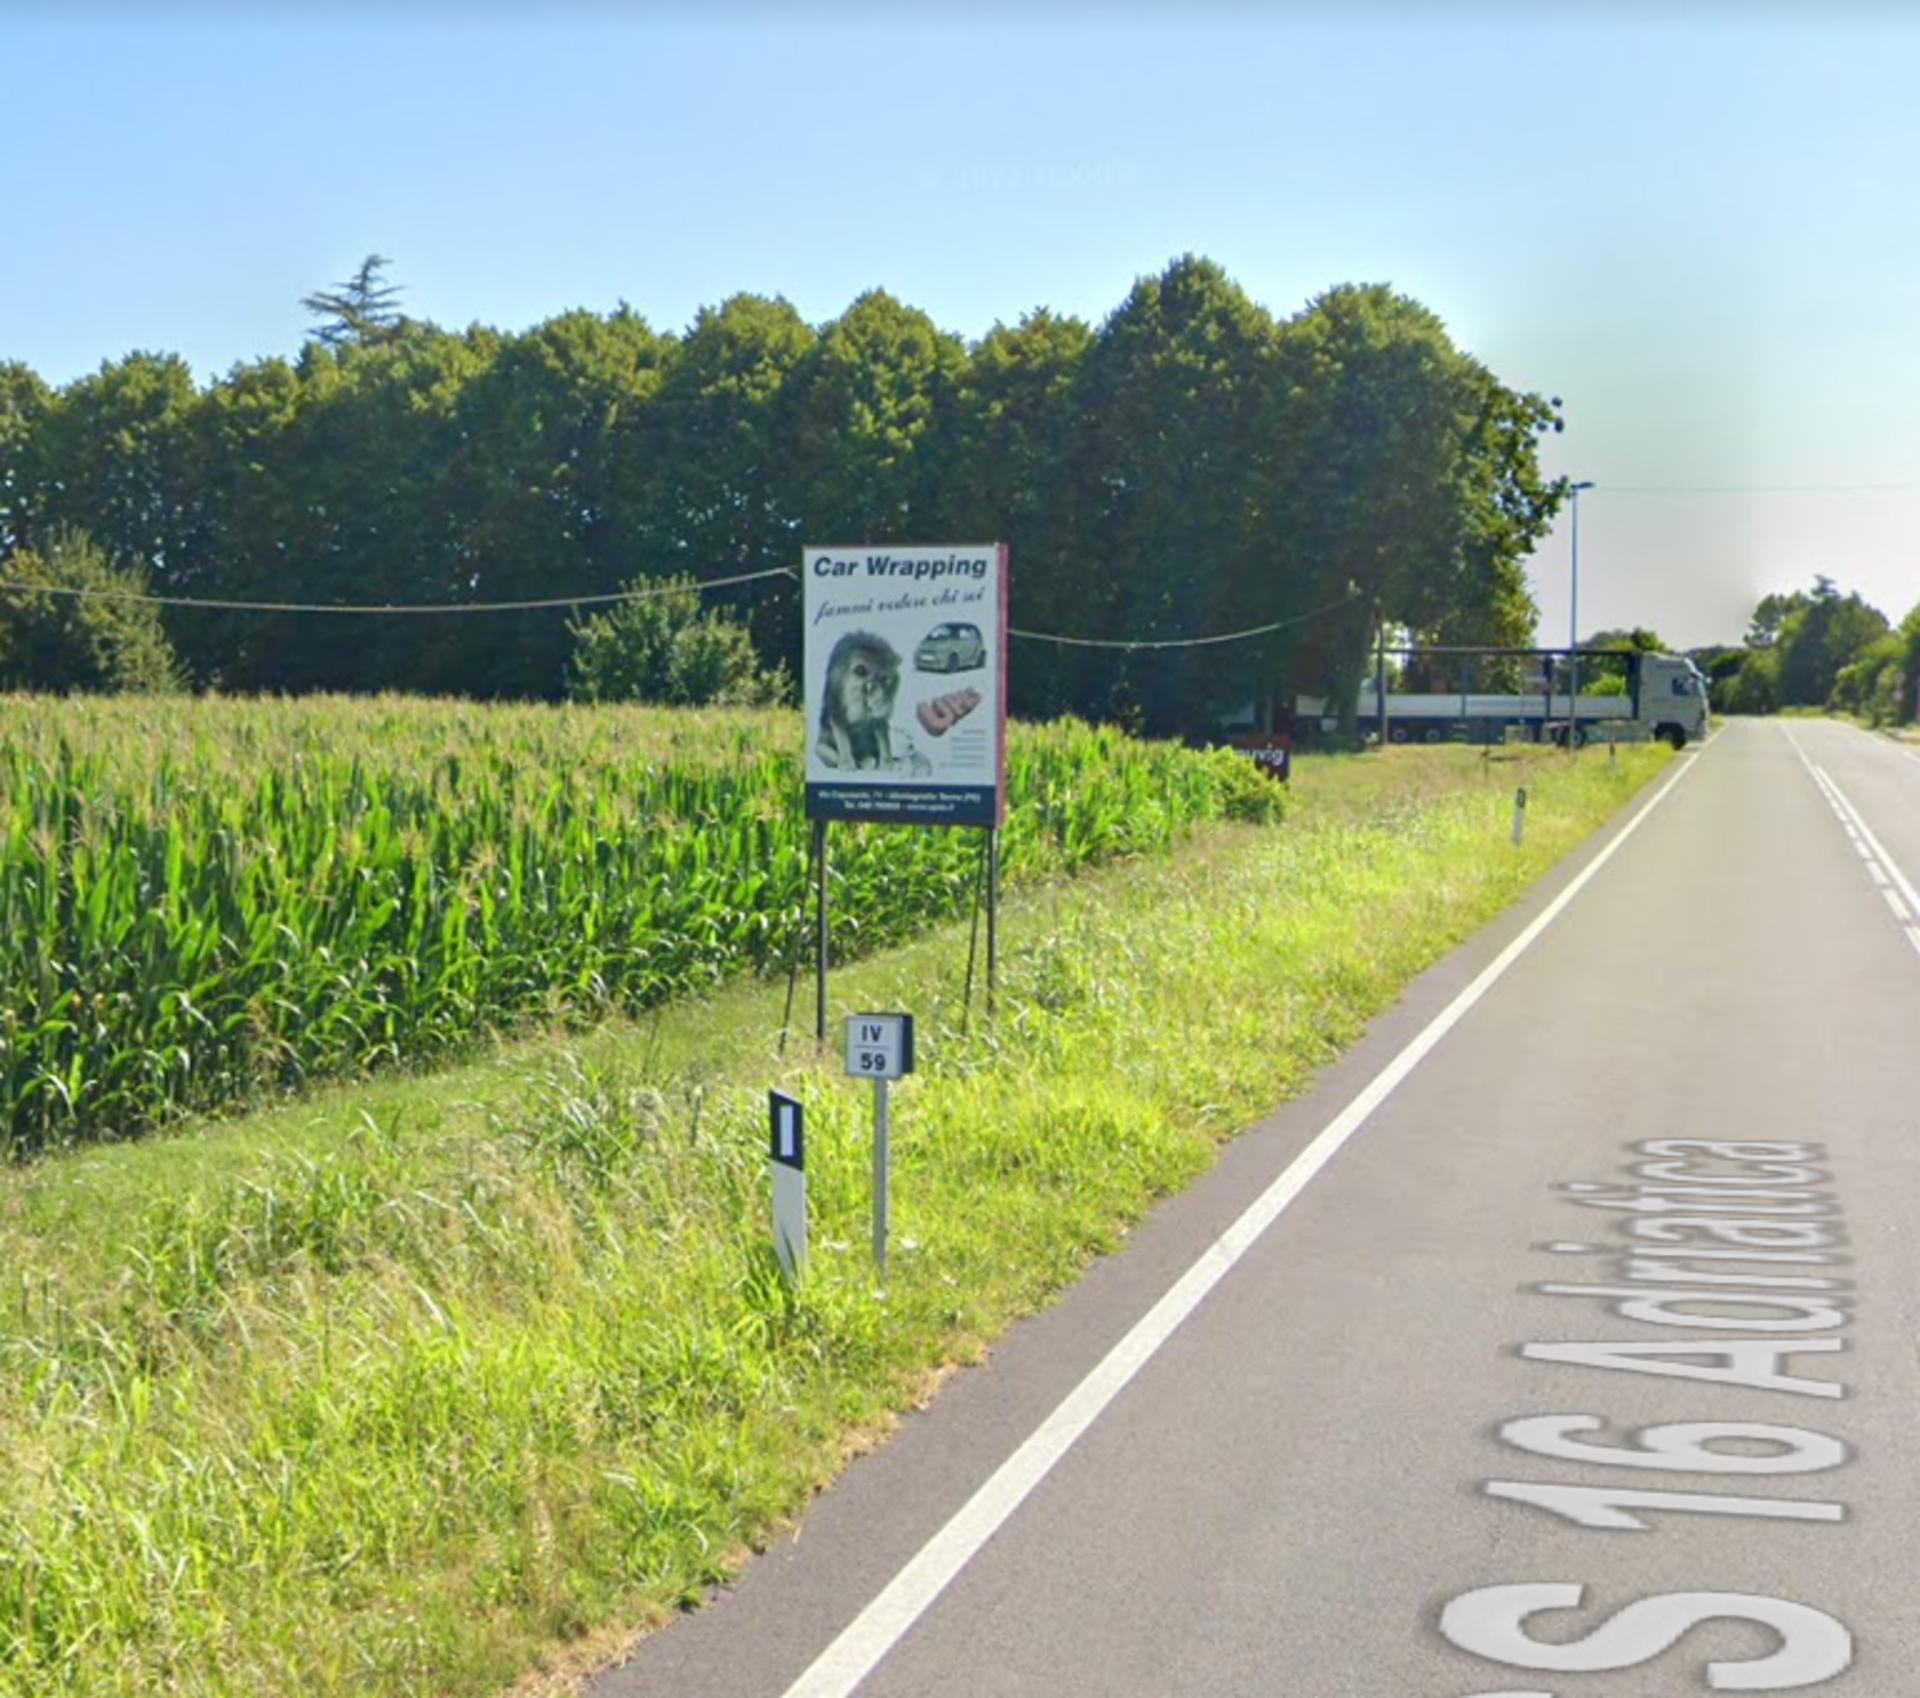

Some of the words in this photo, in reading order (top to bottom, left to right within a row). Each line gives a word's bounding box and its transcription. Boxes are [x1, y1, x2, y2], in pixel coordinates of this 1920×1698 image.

[814, 556, 858, 577] Car
[866, 555, 987, 580] Wrapping
[931, 587, 959, 606] chi
[862, 1024, 883, 1043] IV
[861, 1052, 886, 1071] 59
